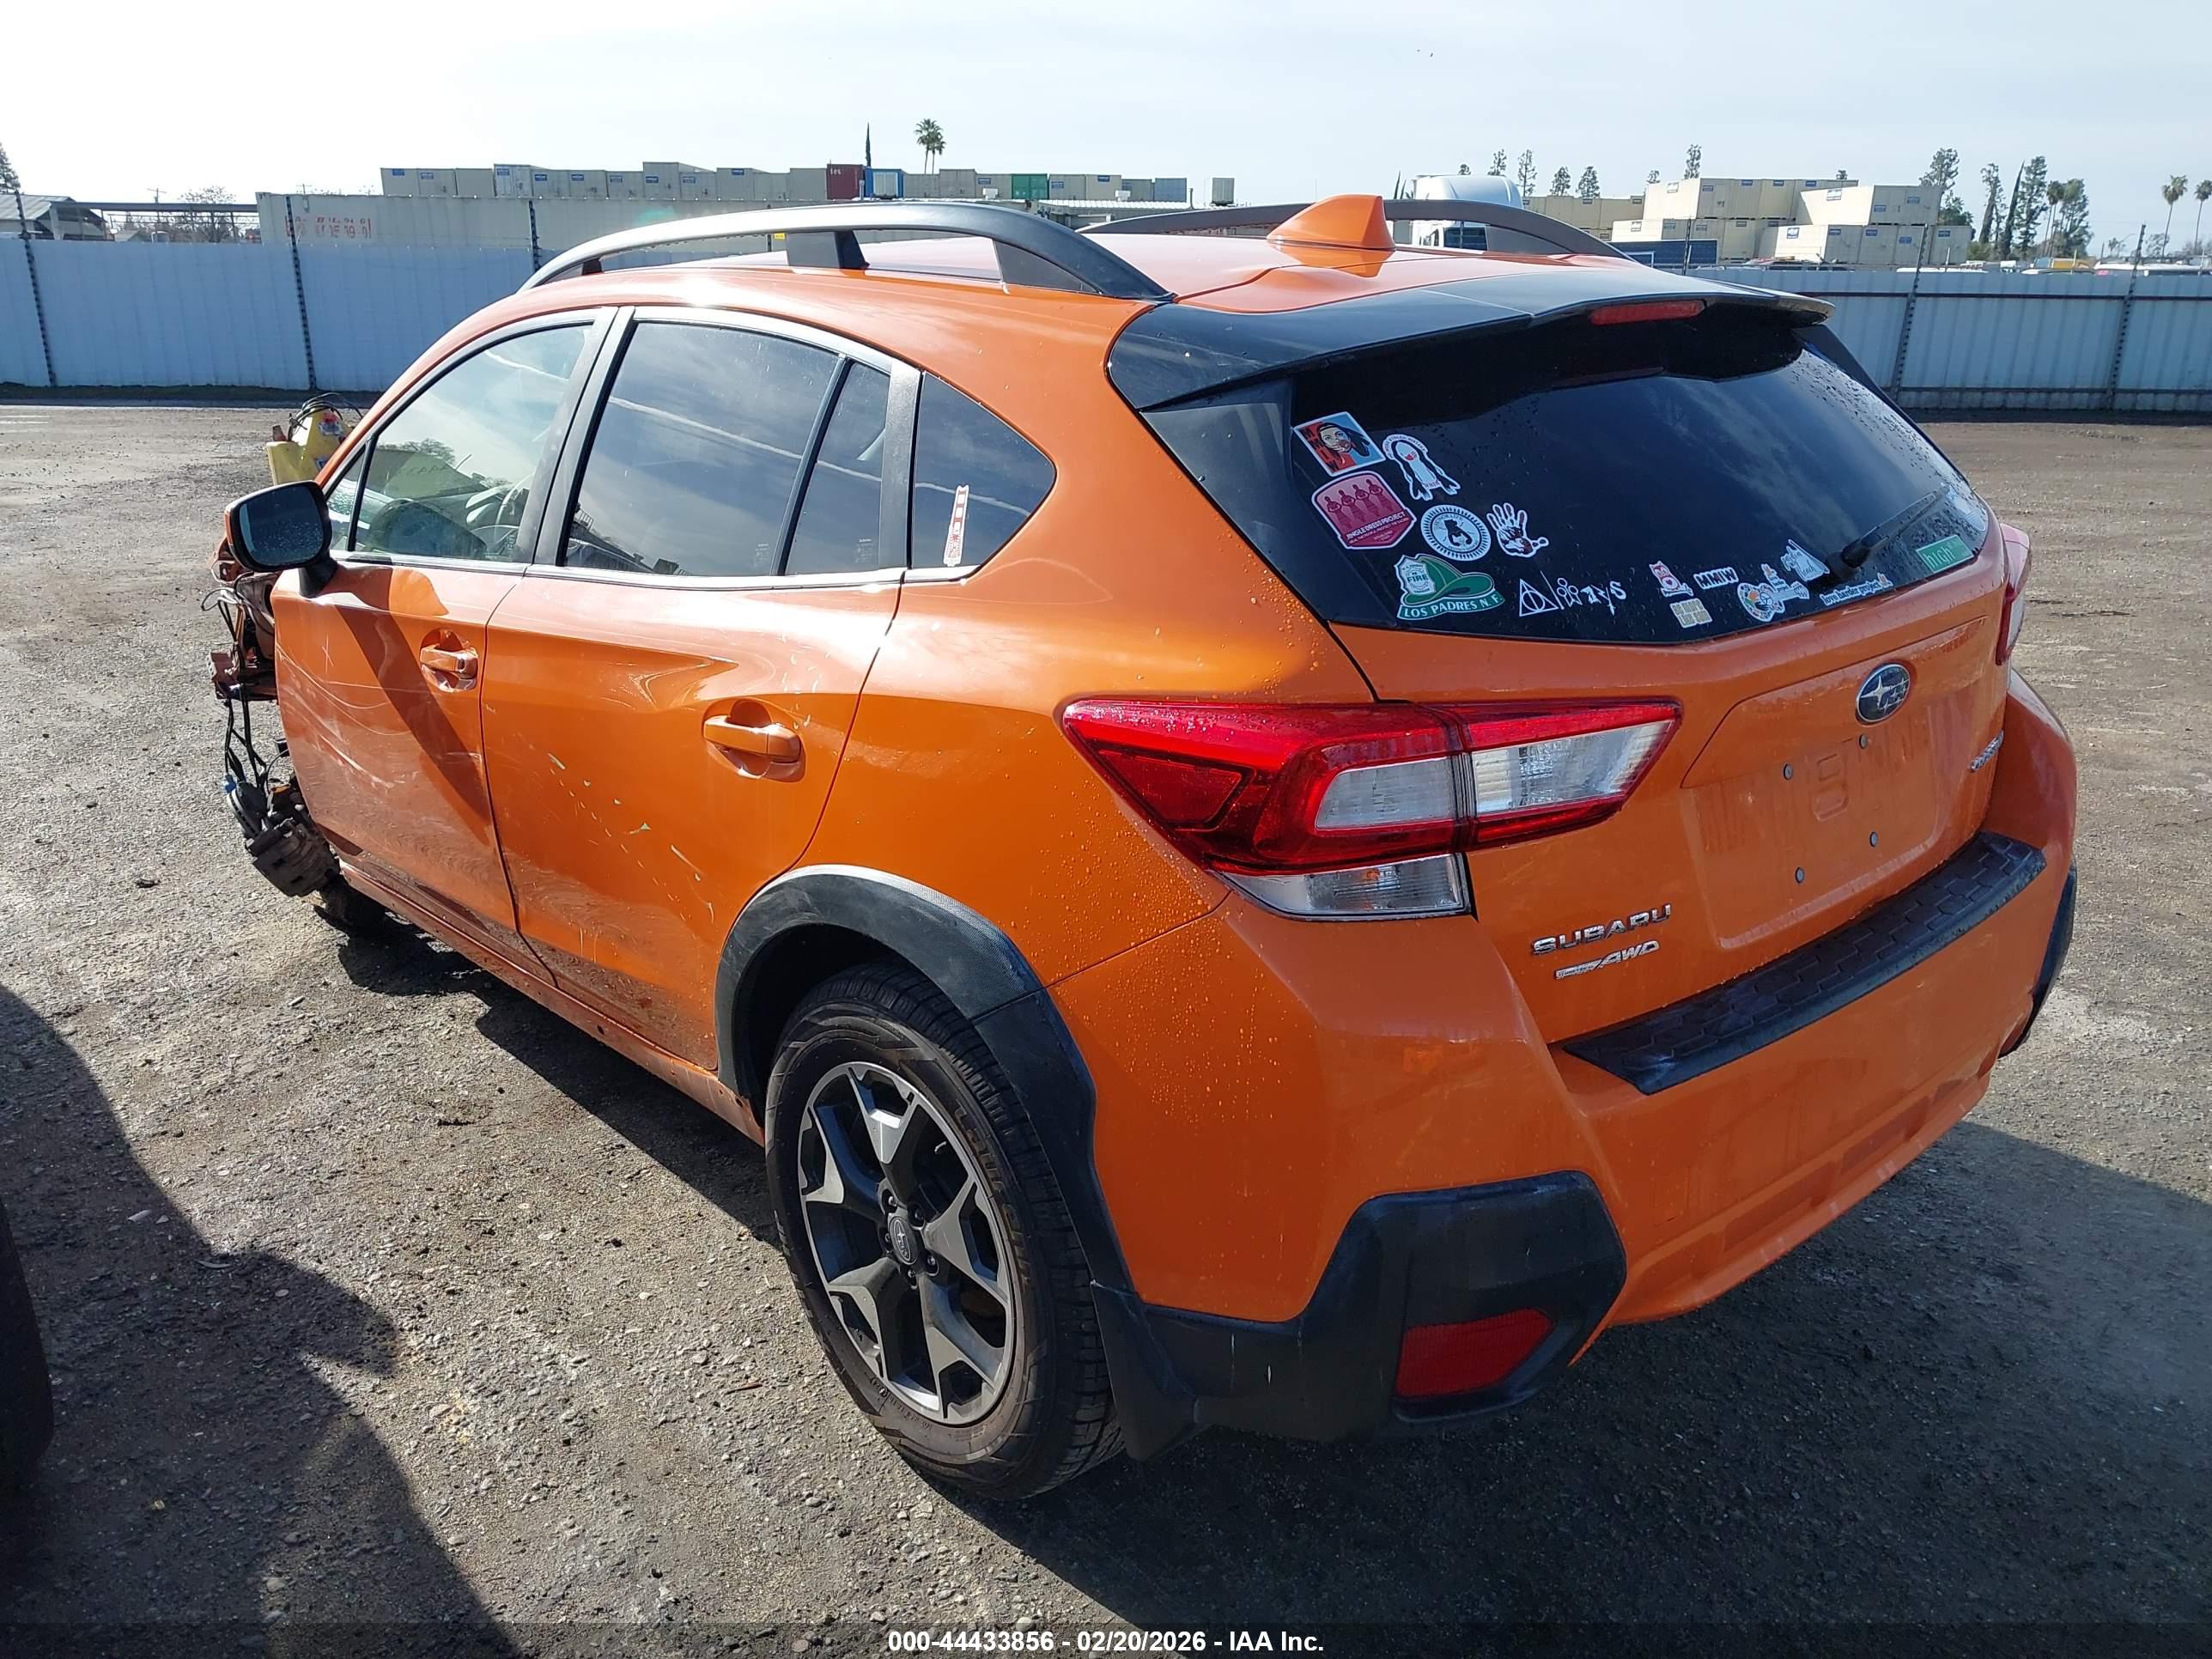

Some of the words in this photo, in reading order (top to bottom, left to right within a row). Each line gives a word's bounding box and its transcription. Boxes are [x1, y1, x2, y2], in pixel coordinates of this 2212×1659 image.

[1407, 574, 1429, 583] FIRE
[1696, 568, 1736, 587] MMIW
[1403, 606, 1428, 618] LOS
[1430, 599, 1478, 615] PADRES
[1479, 598, 1492, 608] N.
[1820, 594, 1839, 605] love
[1532, 904, 1671, 954] SUBARU
[1601, 940, 1660, 968] AWD
